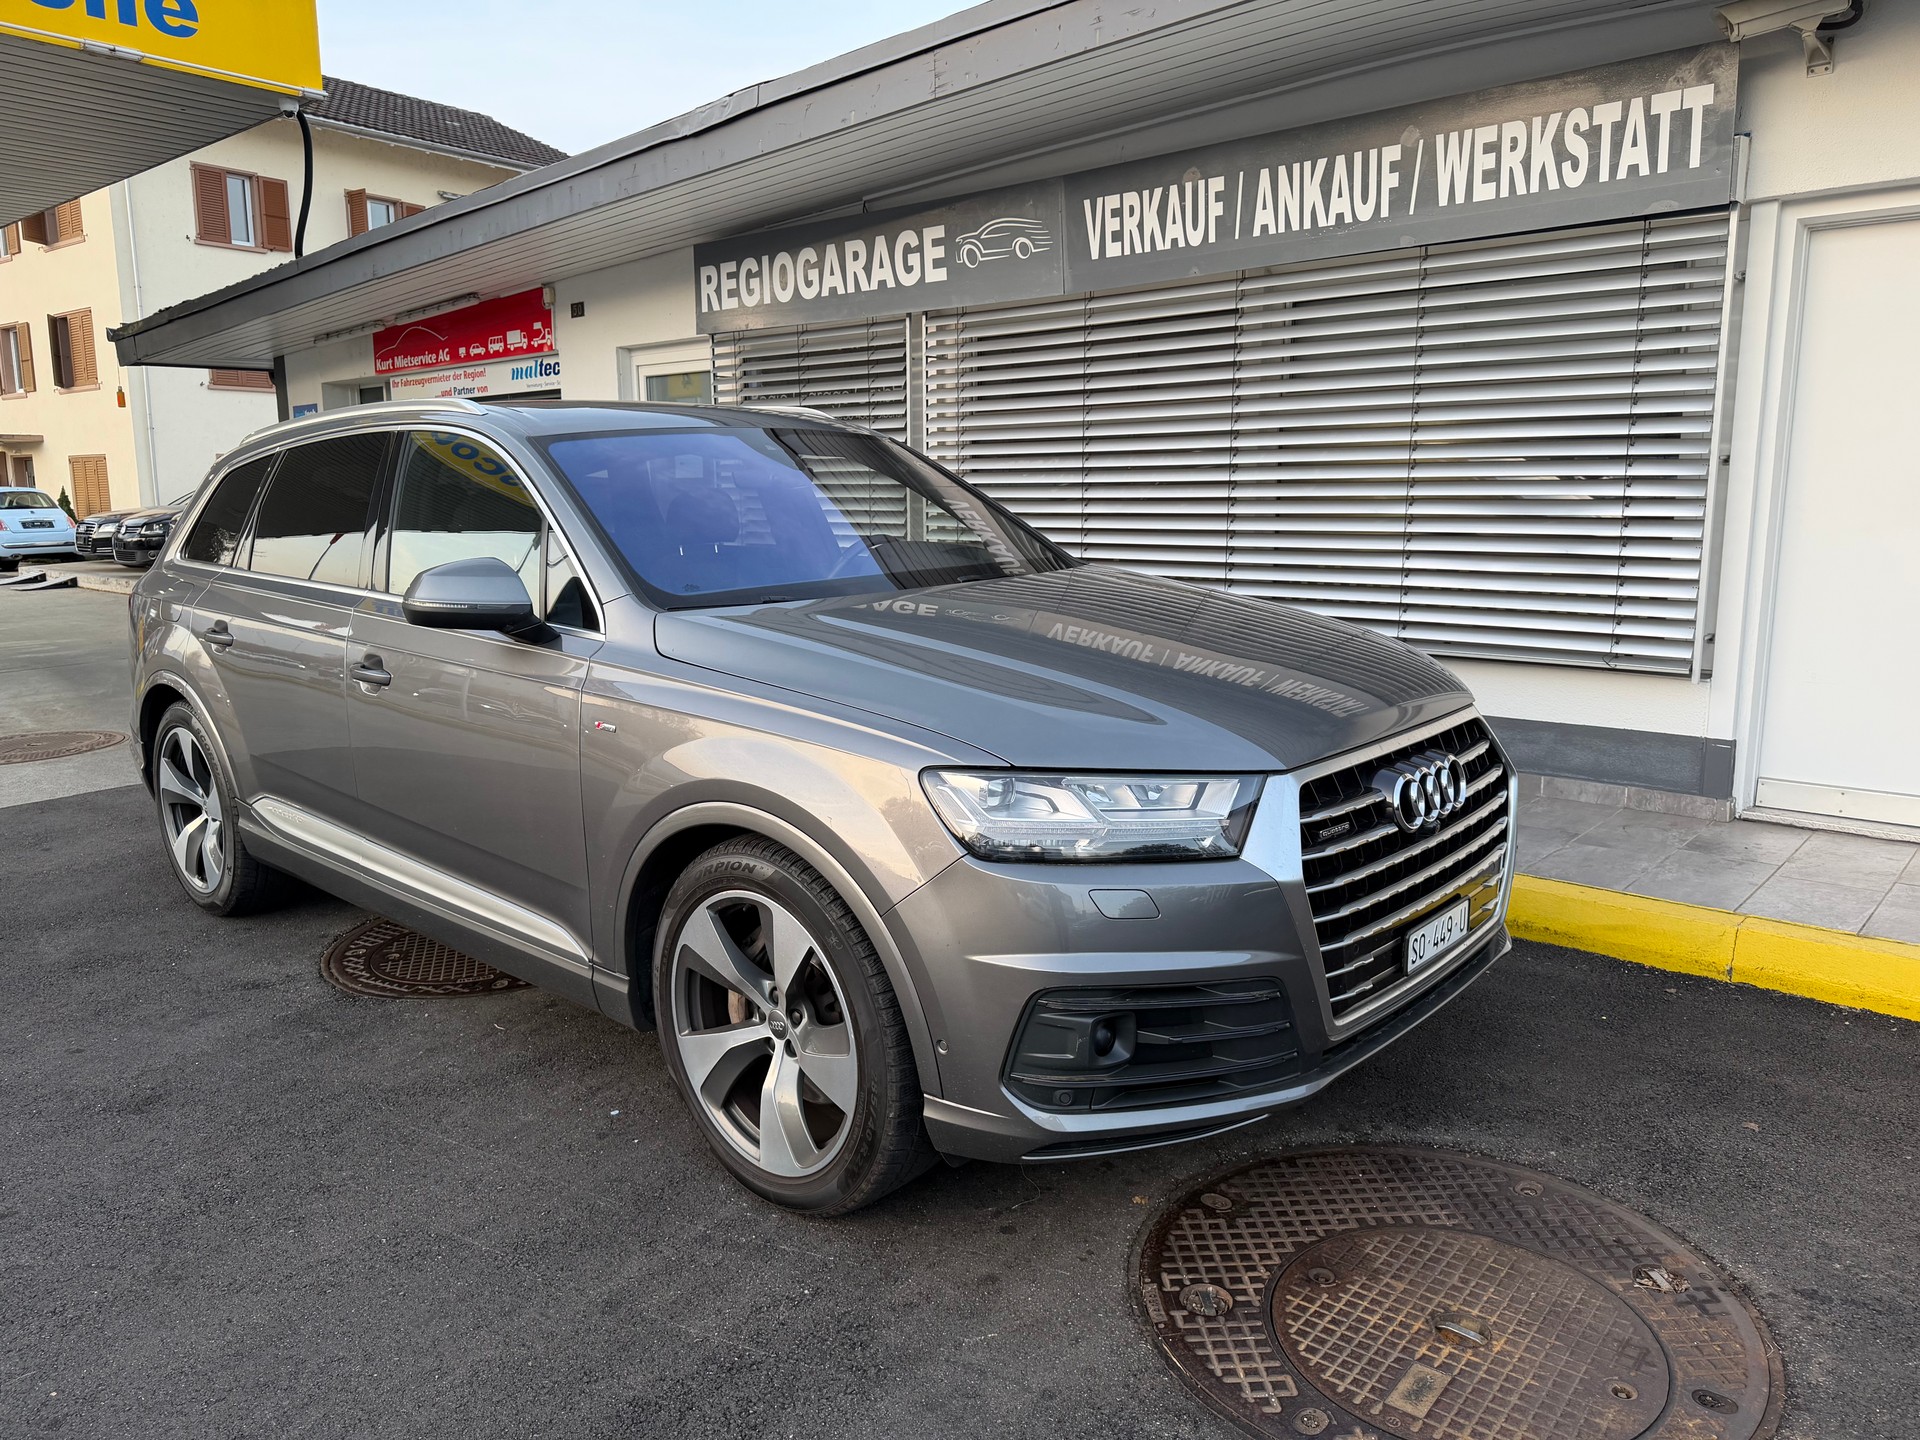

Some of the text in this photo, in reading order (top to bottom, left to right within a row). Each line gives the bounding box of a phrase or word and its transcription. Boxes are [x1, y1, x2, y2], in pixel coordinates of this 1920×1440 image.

[1083, 176, 1225, 260] VERKAUF
[1252, 144, 1402, 237] ANKAUF
[1435, 83, 1715, 206] WERKSTATT
[700, 225, 948, 313] REGIOGARAGE
[376, 347, 450, 371] Kurt Mietservice AG
[391, 367, 487, 389] Ihr Fahrzeugvermieter der Region!
[453, 386, 476, 396] Partner
[476, 385, 489, 394] von
